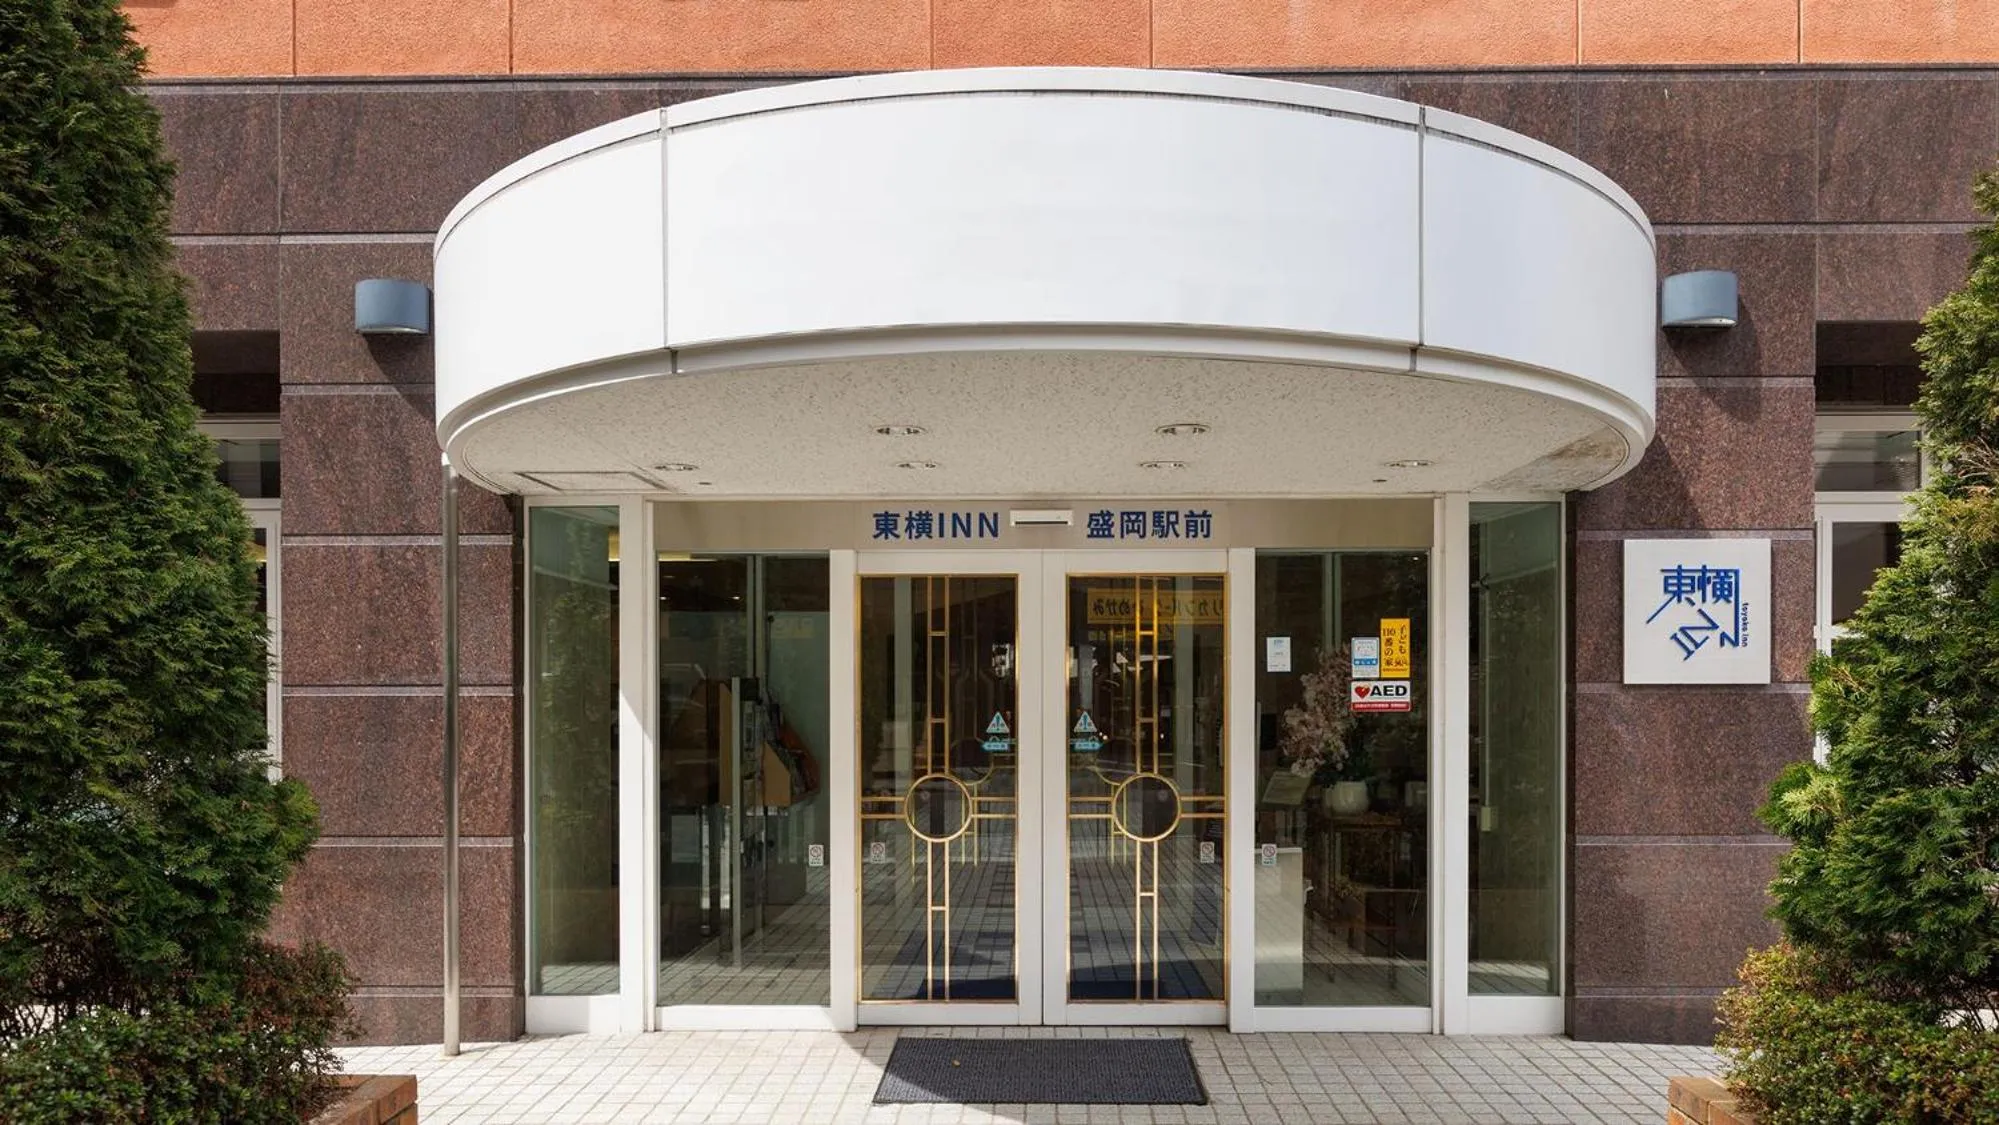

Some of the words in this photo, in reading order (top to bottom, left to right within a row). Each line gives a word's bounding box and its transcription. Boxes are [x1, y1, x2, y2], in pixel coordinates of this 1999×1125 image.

[872, 511, 999, 539] 東横INN
[1086, 510, 1212, 539] 盛岡駅前
[1370, 685, 1408, 697] AED
